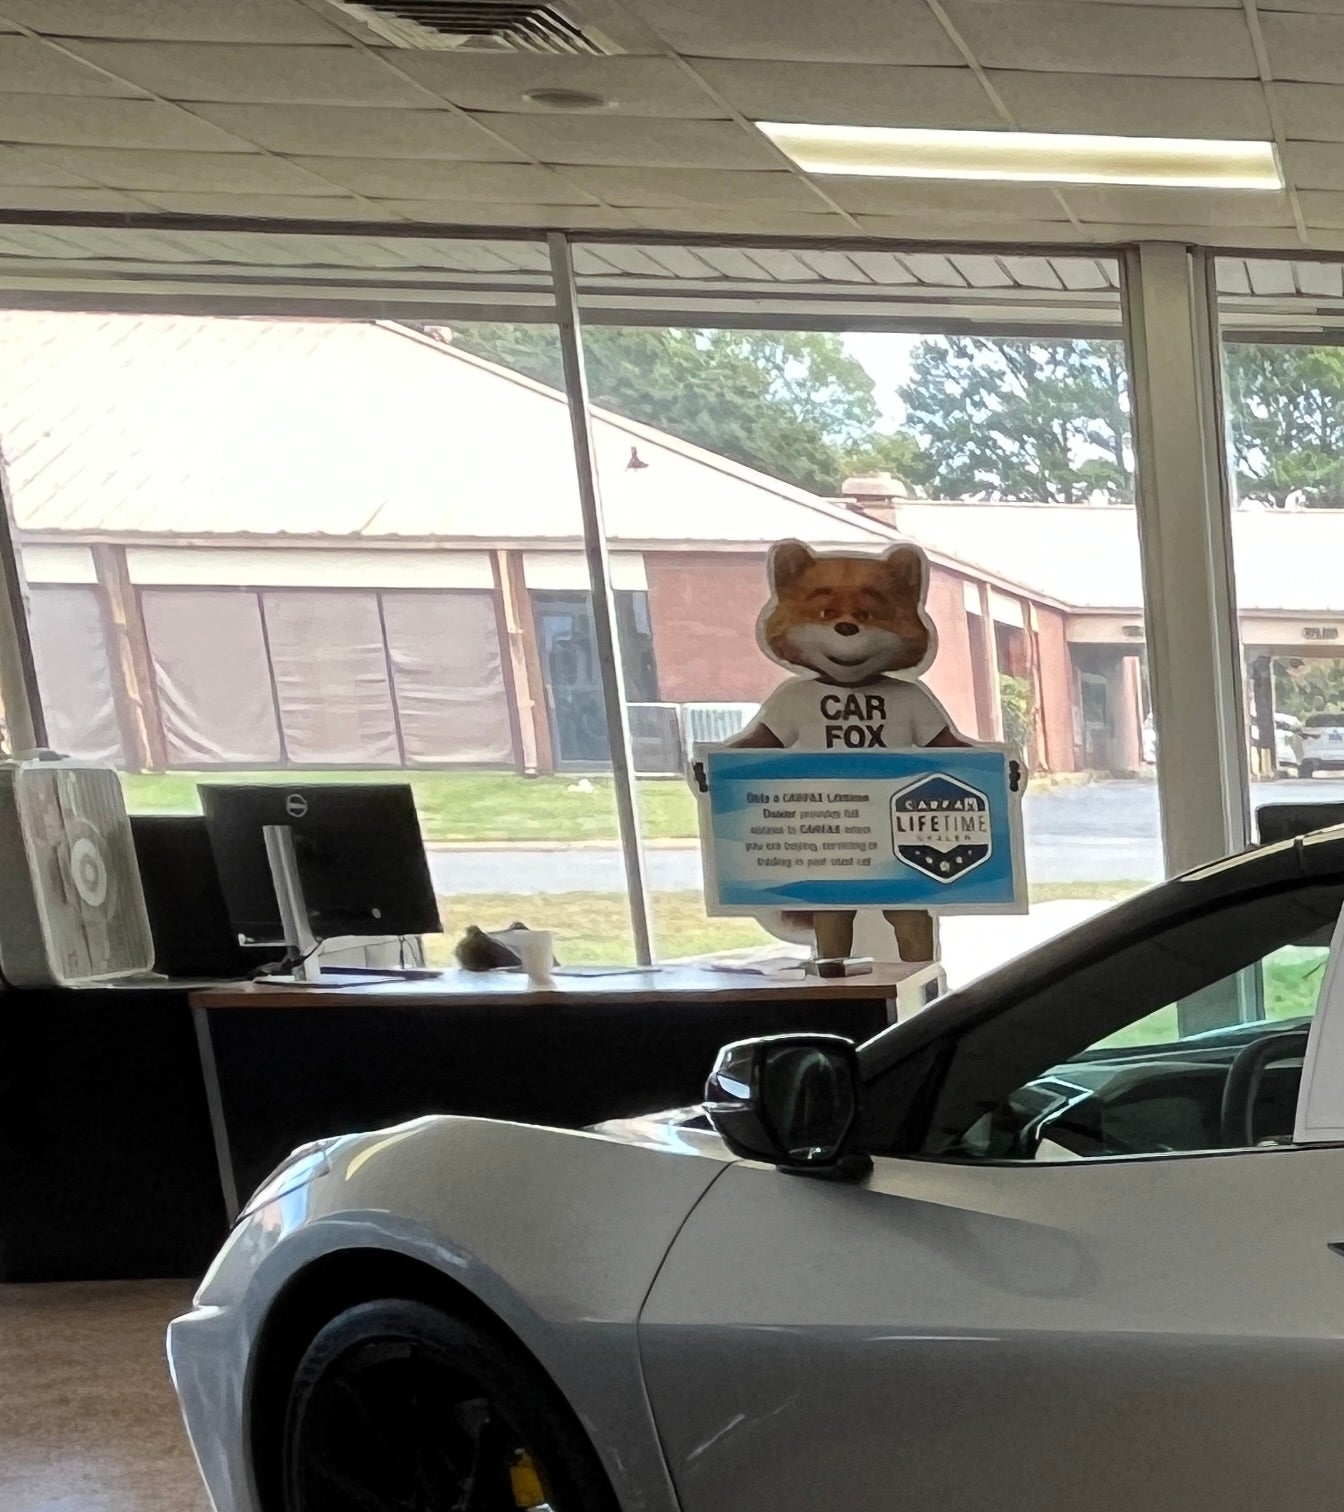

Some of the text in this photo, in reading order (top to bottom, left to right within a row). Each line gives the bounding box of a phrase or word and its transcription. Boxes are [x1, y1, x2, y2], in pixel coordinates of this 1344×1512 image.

[820, 694, 887, 721] CAR
[825, 724, 887, 748] FOX
[896, 815, 987, 832] LIFETIME
